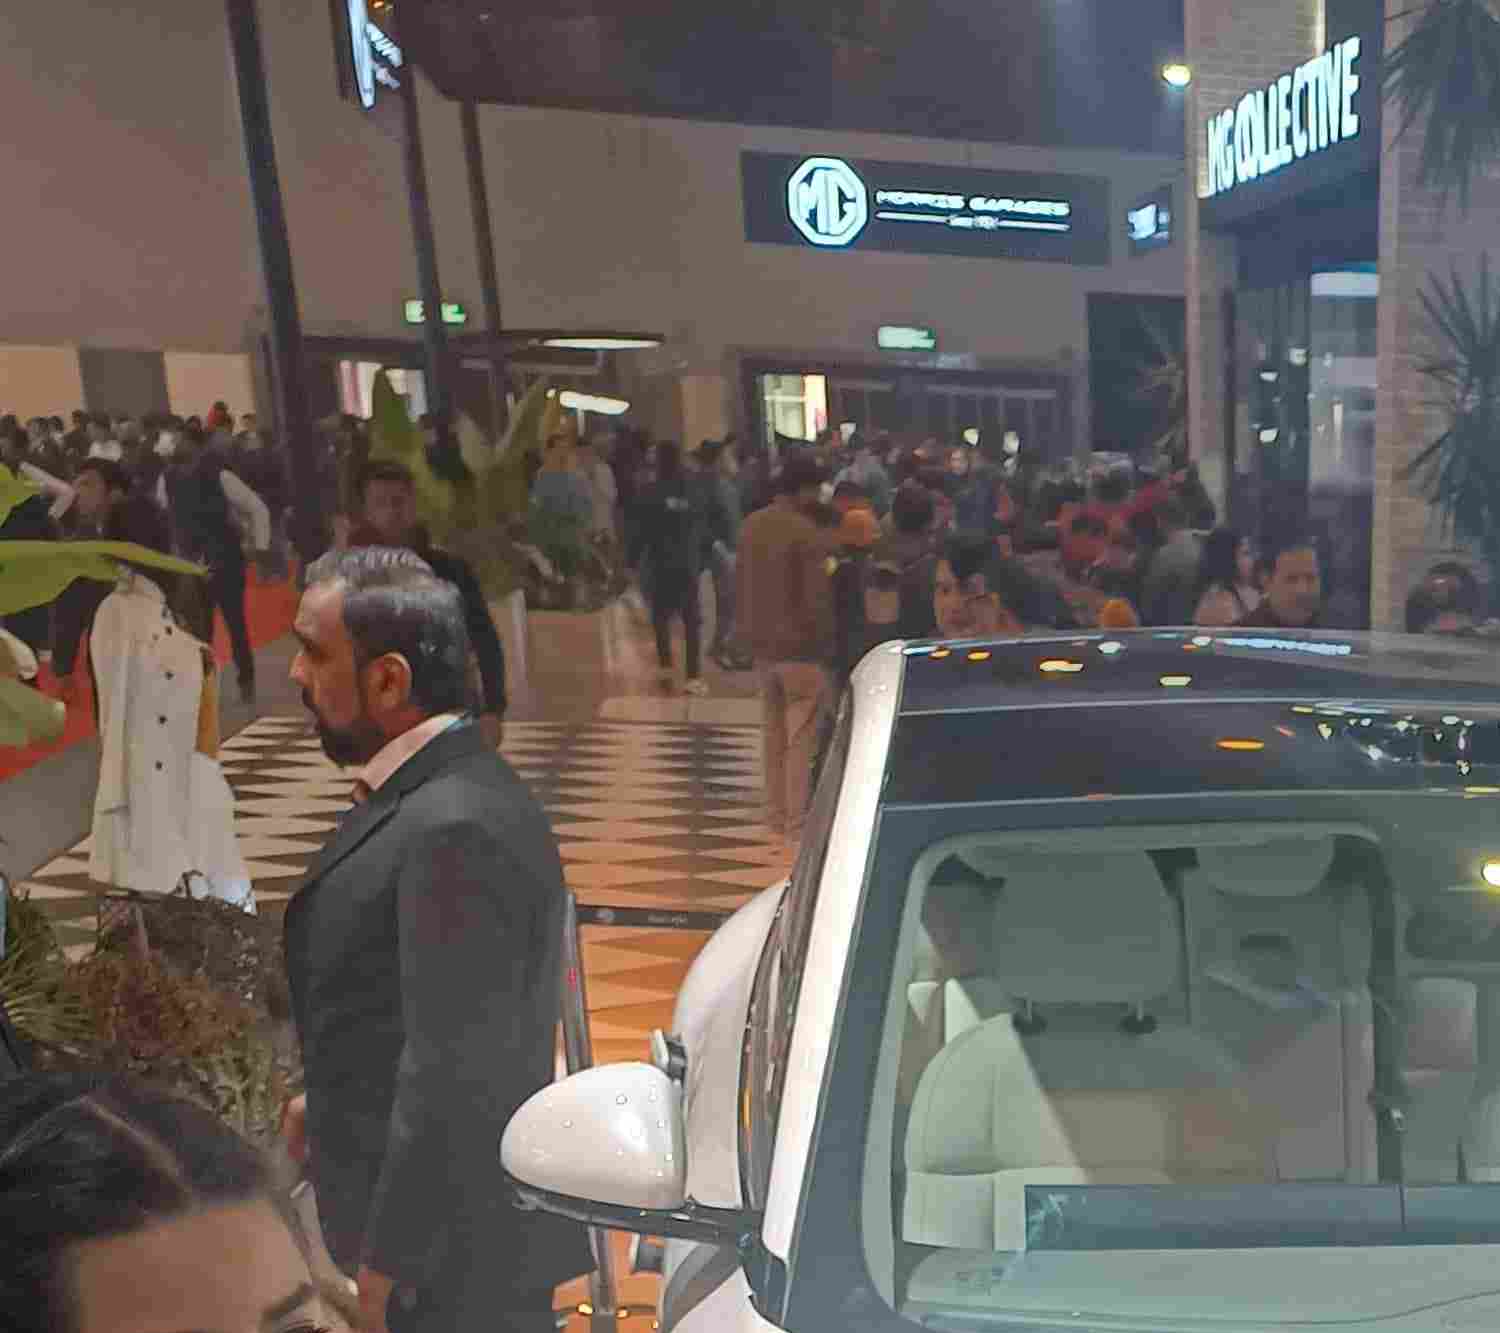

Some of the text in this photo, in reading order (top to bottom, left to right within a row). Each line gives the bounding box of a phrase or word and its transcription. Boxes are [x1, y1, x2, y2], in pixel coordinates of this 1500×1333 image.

[1207, 36, 1360, 195] MG COLLECTIVE
[797, 165, 858, 236] MG
